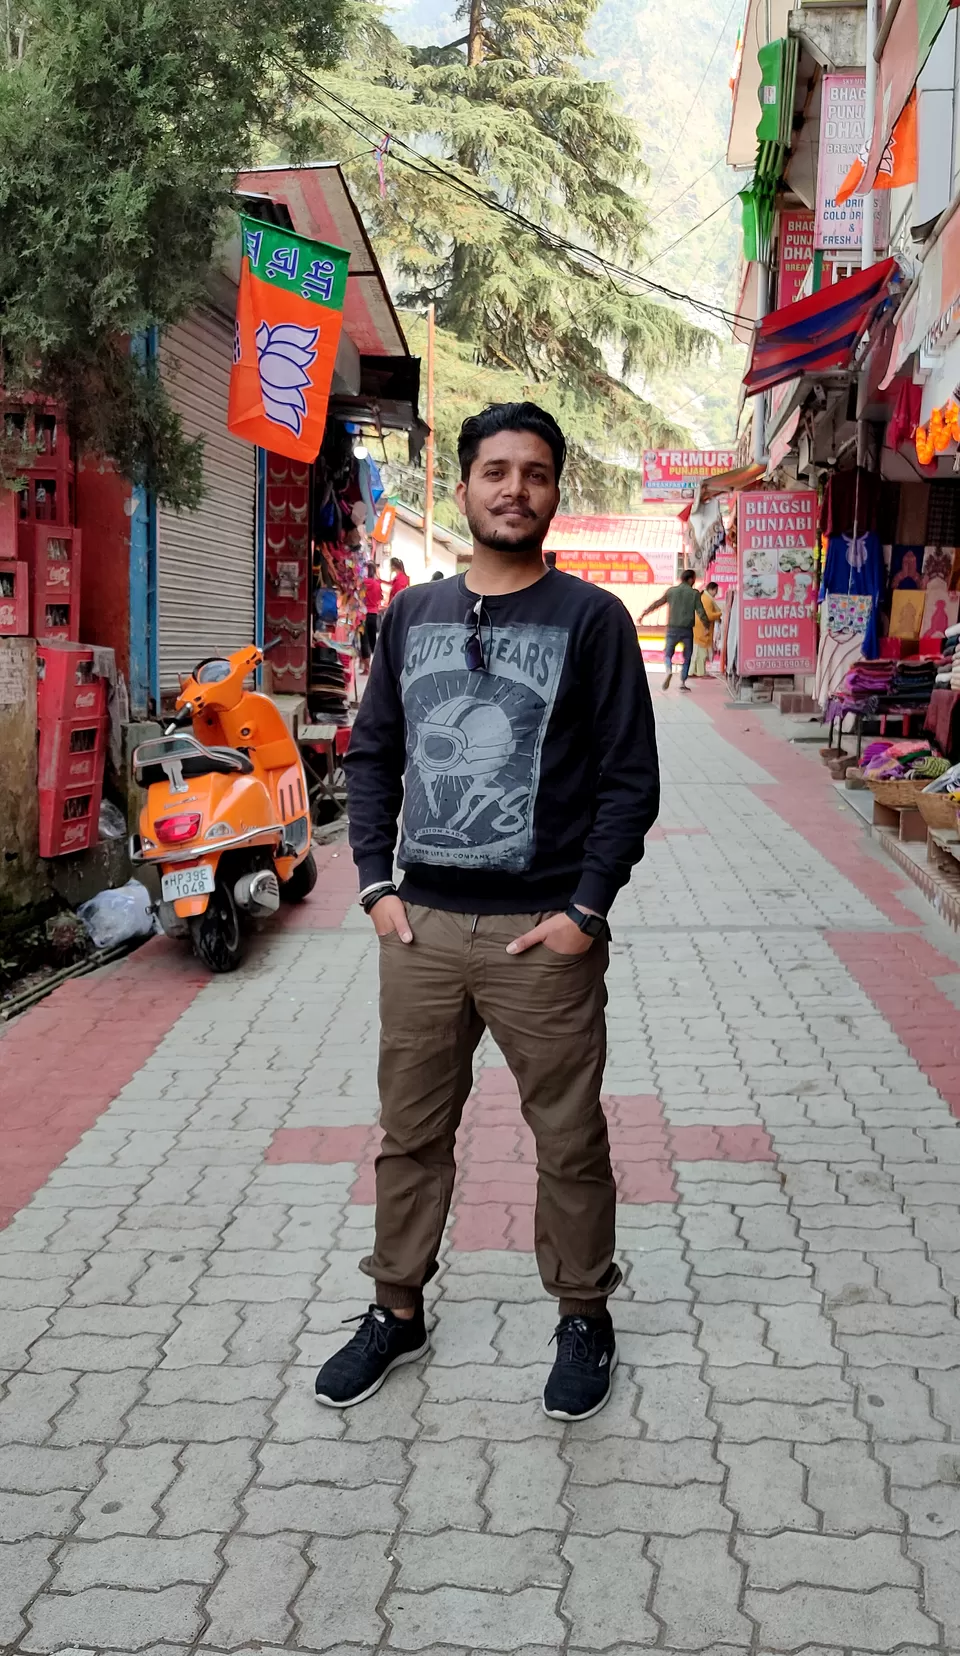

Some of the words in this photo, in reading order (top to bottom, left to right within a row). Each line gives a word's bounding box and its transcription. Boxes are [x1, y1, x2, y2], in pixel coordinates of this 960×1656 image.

[829, 87, 866, 101] BHAG
[823, 211, 846, 220] COLD
[848, 223, 855, 232] &
[822, 235, 851, 245] FRESH
[669, 467, 708, 476] PUNJABI
[745, 500, 811, 515] BHAGSU
[745, 516, 813, 532] PUNJABI
[751, 534, 807, 549] DHABA
[743, 605, 811, 621] BREAKFAST
[757, 624, 799, 639] LUNCH
[755, 643, 800, 658] DINNER
[405, 635, 456, 677] GUTS
[482, 638, 554, 688] GEARS
[445, 830, 464, 838] MADE
[176, 880, 206, 897] 1048
